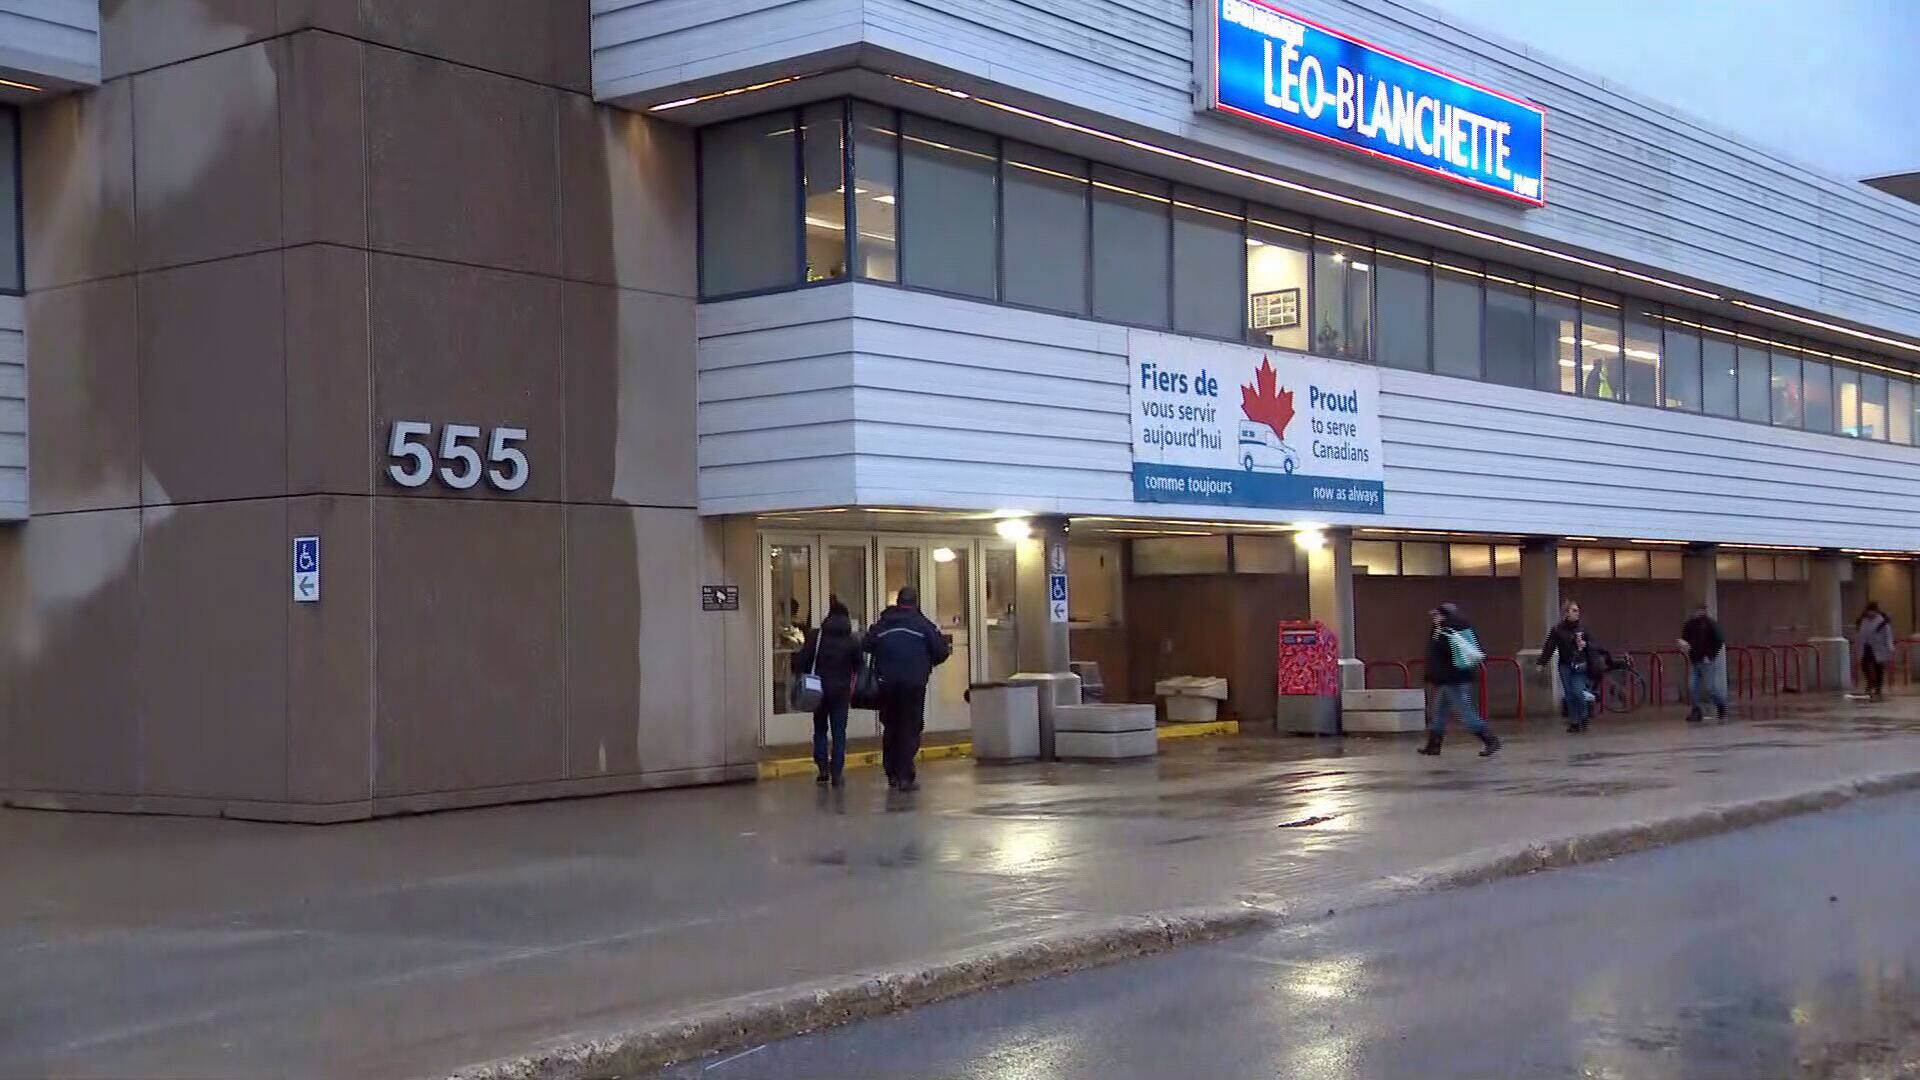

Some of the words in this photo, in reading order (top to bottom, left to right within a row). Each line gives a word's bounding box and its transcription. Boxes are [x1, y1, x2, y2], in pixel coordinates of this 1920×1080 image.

[1141, 363, 1188, 394] Fiers
[1195, 369, 1218, 397] de
[1310, 385, 1358, 414] Proud
[1142, 401, 1174, 418] vous
[1179, 402, 1216, 422] servir
[1143, 423, 1222, 450] aujourd'hui
[1312, 416, 1324, 434] to
[1327, 421, 1356, 437] serve
[388, 421, 531, 491] 555
[1312, 440, 1369, 462] Canadians
[1145, 475, 1185, 491] comme
[1188, 475, 1233, 496] toujours
[1313, 486, 1334, 500] now
[1336, 489, 1346, 500] as
[1348, 485, 1379, 505] always
